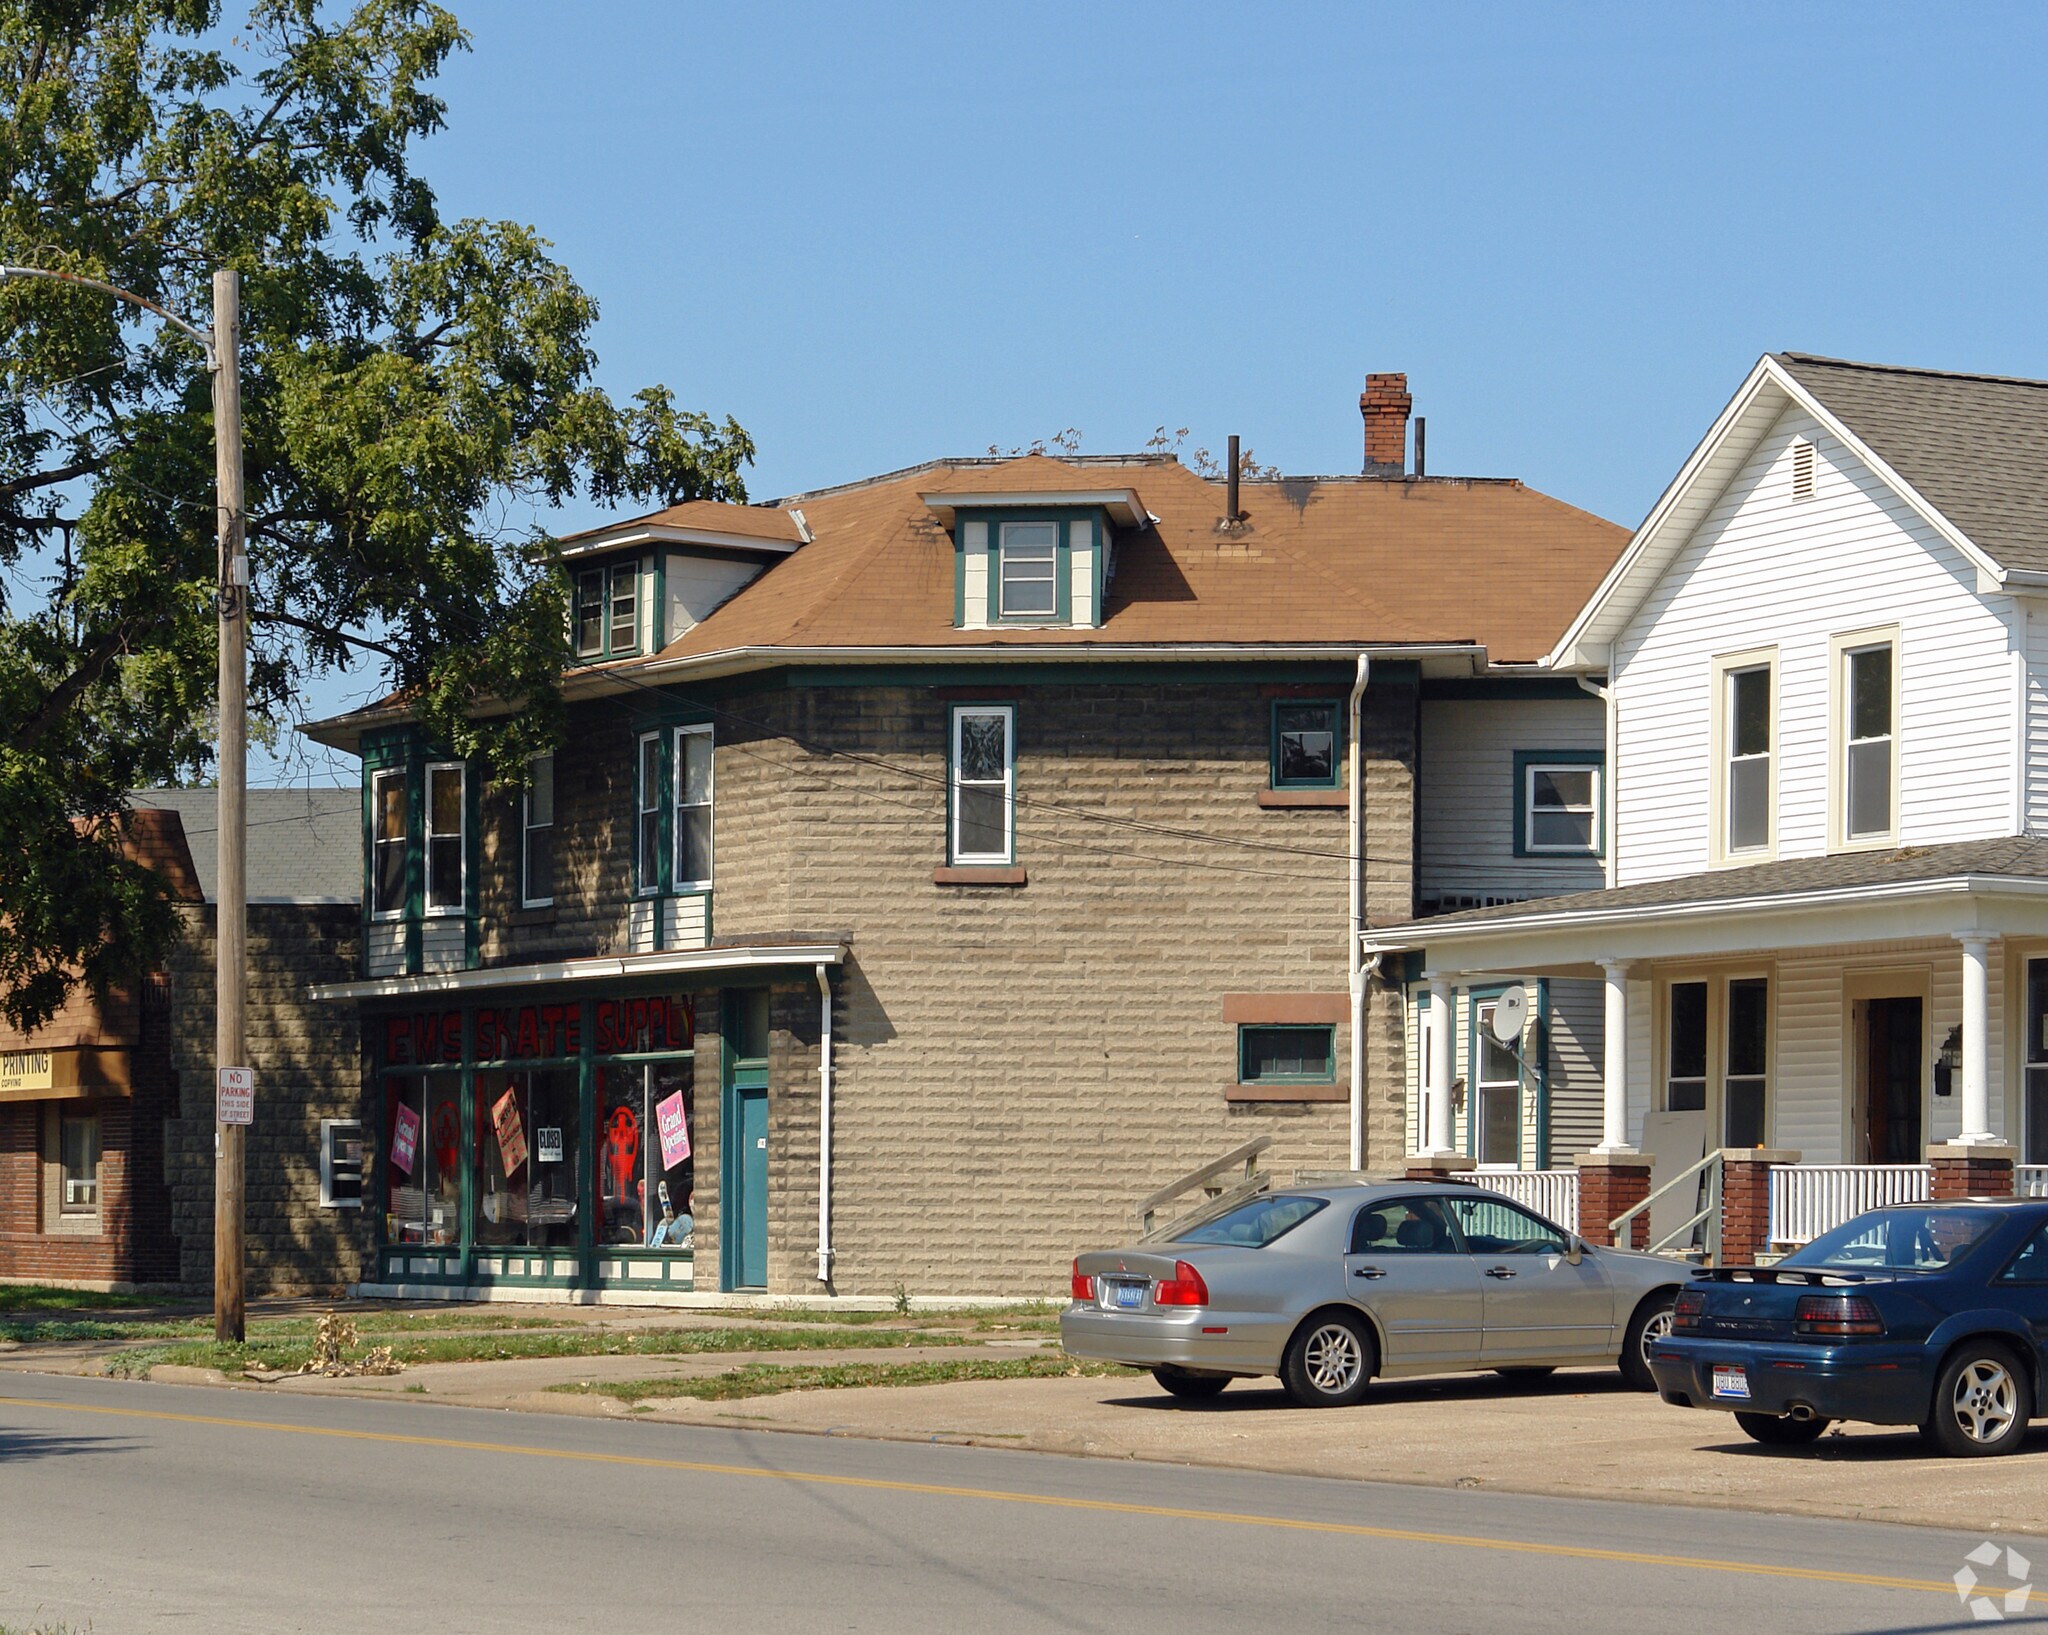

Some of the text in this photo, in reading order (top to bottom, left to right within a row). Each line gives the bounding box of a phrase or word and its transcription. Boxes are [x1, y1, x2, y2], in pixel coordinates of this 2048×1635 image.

[475, 1004, 581, 1060] SKATE
[596, 994, 695, 1051] SUPPLY
[3, 1050, 49, 1075] PRINTING
[229, 1072, 243, 1084] NO
[221, 1086, 250, 1098] PARKING
[220, 1110, 250, 1118] OF STREET
[221, 1100, 250, 1109] THIS SIDE
[661, 1103, 682, 1134] Grand
[539, 1130, 561, 1149] CLOSED
[663, 1127, 686, 1154] Opening
